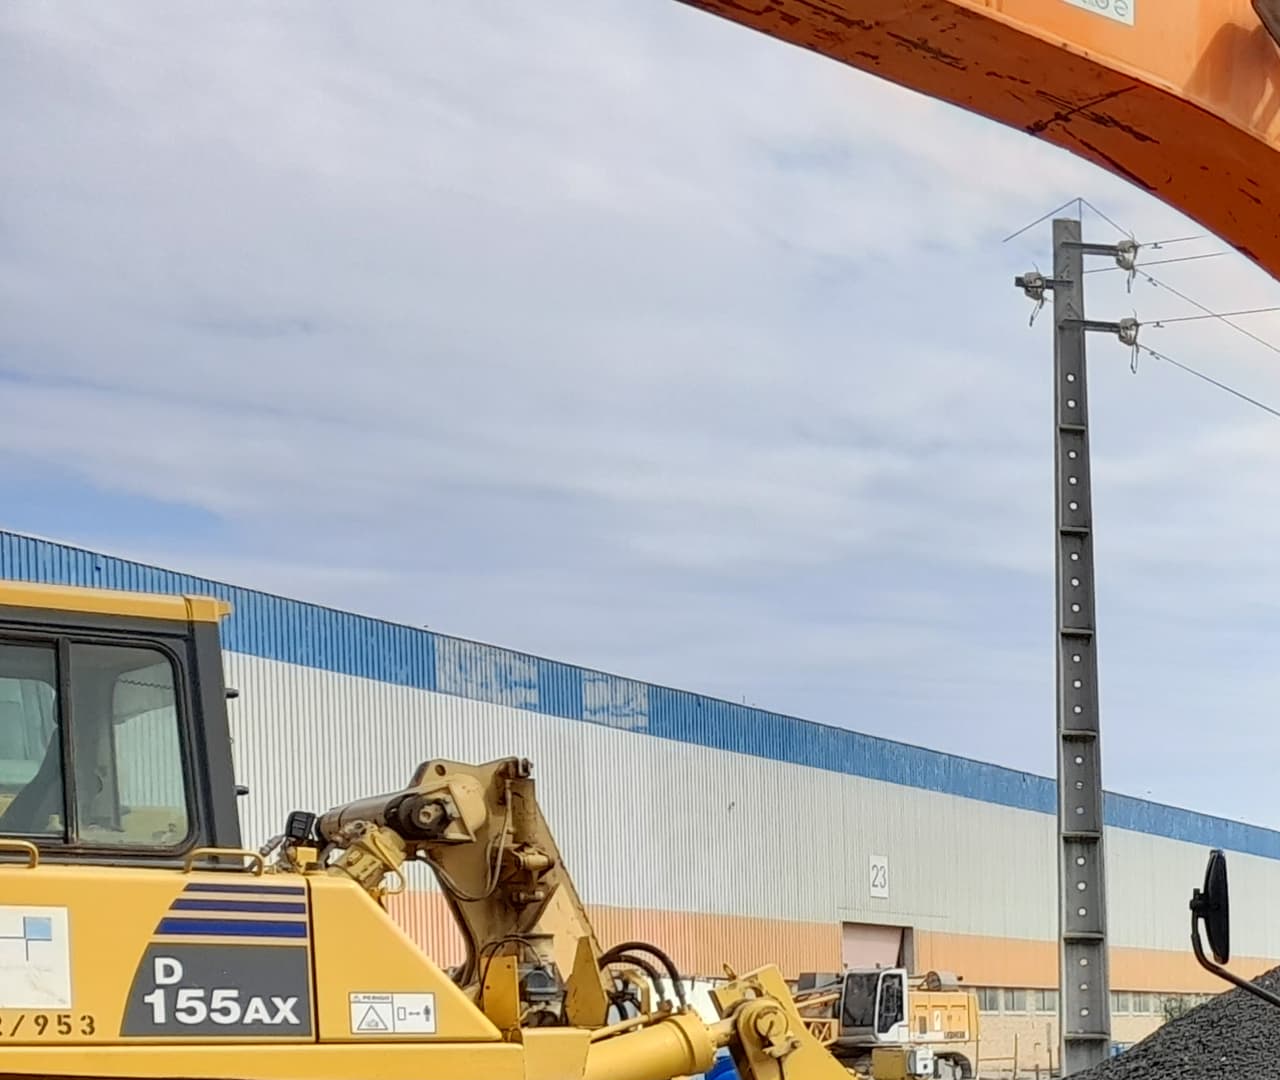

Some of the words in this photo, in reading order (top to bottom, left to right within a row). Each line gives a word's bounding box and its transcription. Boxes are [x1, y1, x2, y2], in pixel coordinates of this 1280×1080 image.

[872, 864, 886, 888] 23
[154, 957, 183, 985] D
[143, 988, 301, 1025] 155AX
[0, 1014, 96, 1037] /953
